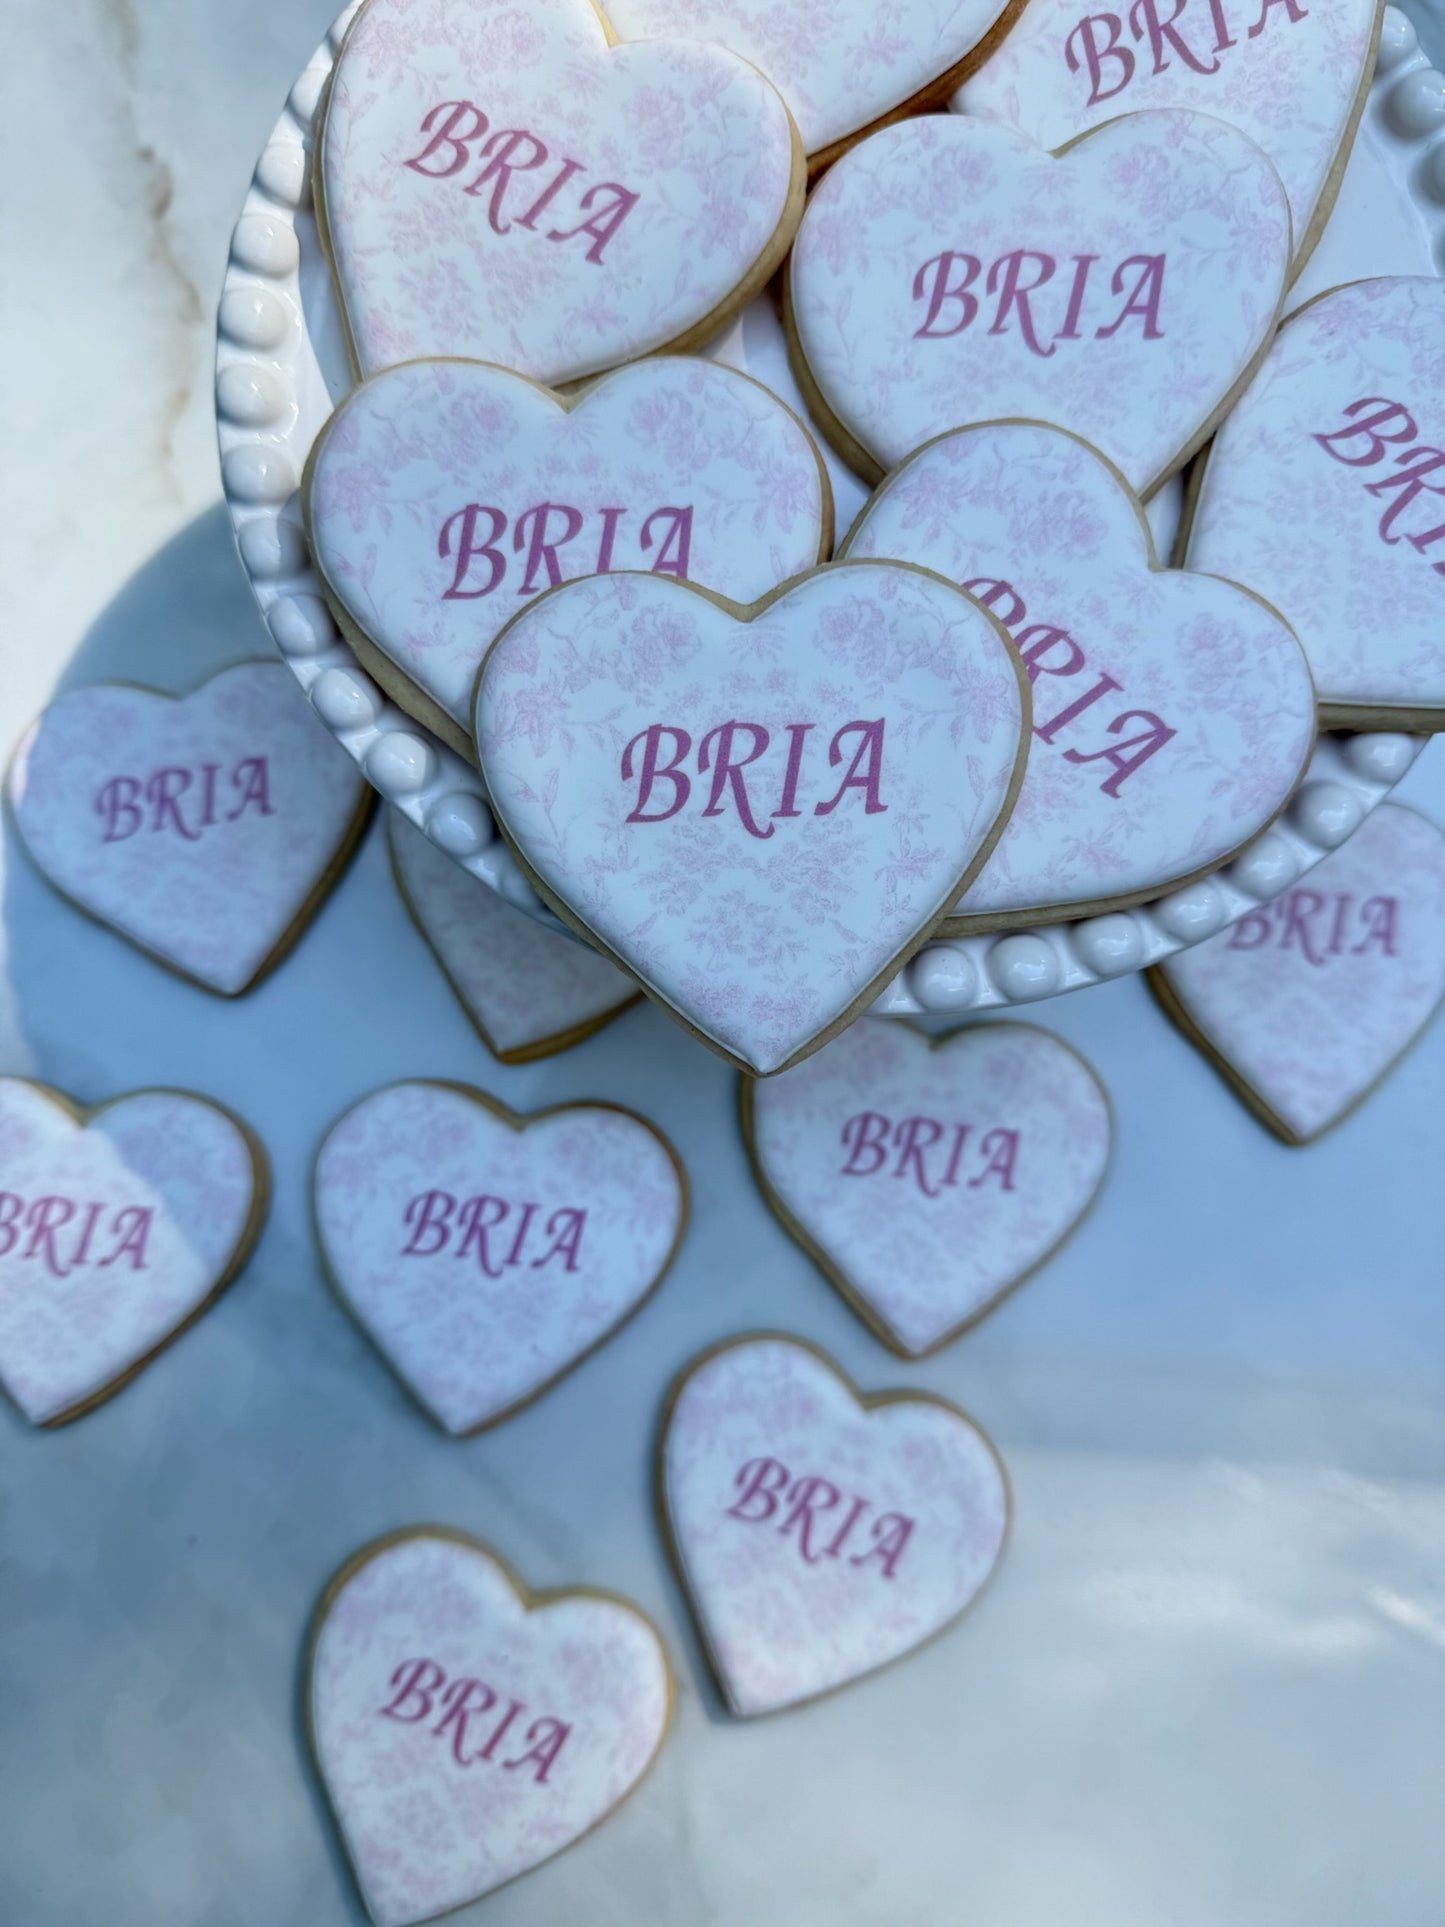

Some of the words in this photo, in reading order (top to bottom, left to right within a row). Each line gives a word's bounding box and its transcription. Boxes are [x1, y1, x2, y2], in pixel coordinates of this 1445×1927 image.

[402, 99, 641, 266] BRIA
[912, 248, 1167, 358] BRIA
[438, 502, 693, 600] BRIA
[93, 755, 275, 843] BRIA
[620, 717, 889, 839] BRIA
[841, 1110, 1020, 1197] BRIA
[402, 1188, 588, 1278] BRIA
[726, 1456, 916, 1579] BRIA
[380, 1657, 573, 1784] BRIA
